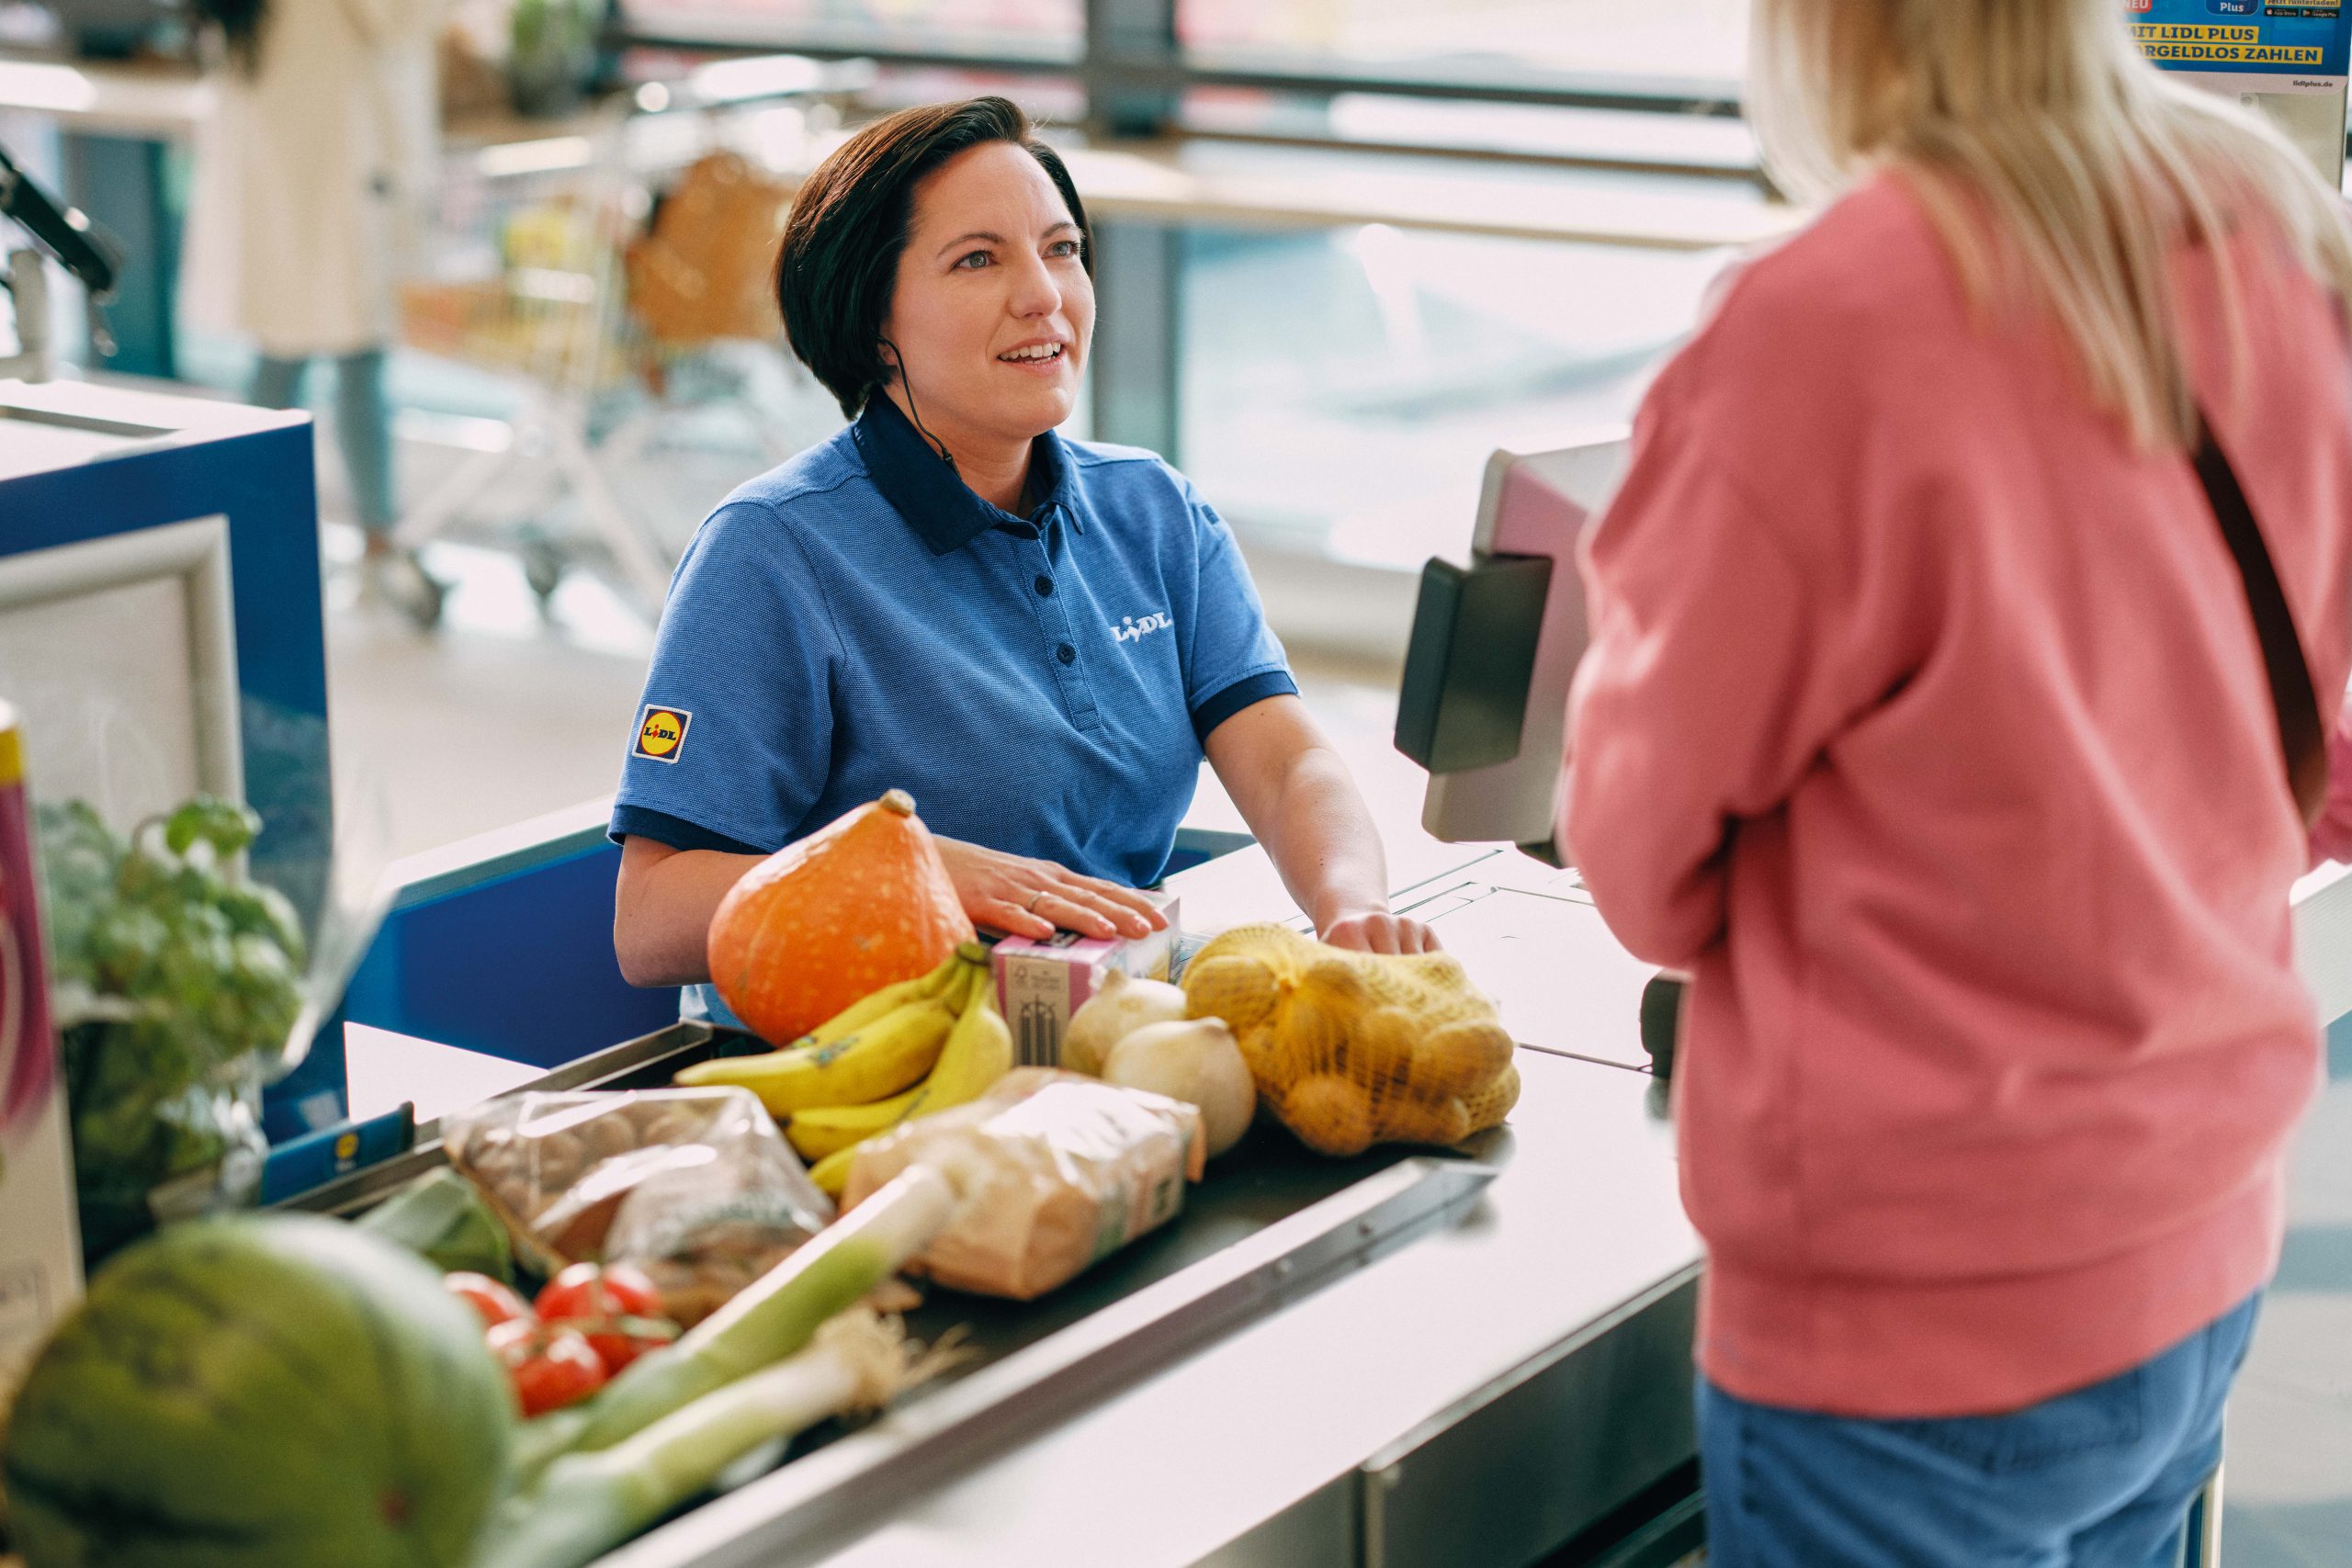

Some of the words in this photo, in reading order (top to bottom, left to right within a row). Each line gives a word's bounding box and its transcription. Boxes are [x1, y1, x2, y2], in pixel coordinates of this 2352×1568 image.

[2220, 2, 2244, 12] Plus
[2161, 27, 2203, 39] LIDL
[2208, 28, 2254, 40] PLUS
[2134, 44, 2240, 59] RGELDLOS
[2245, 48, 2318, 62] ZAHLEN
